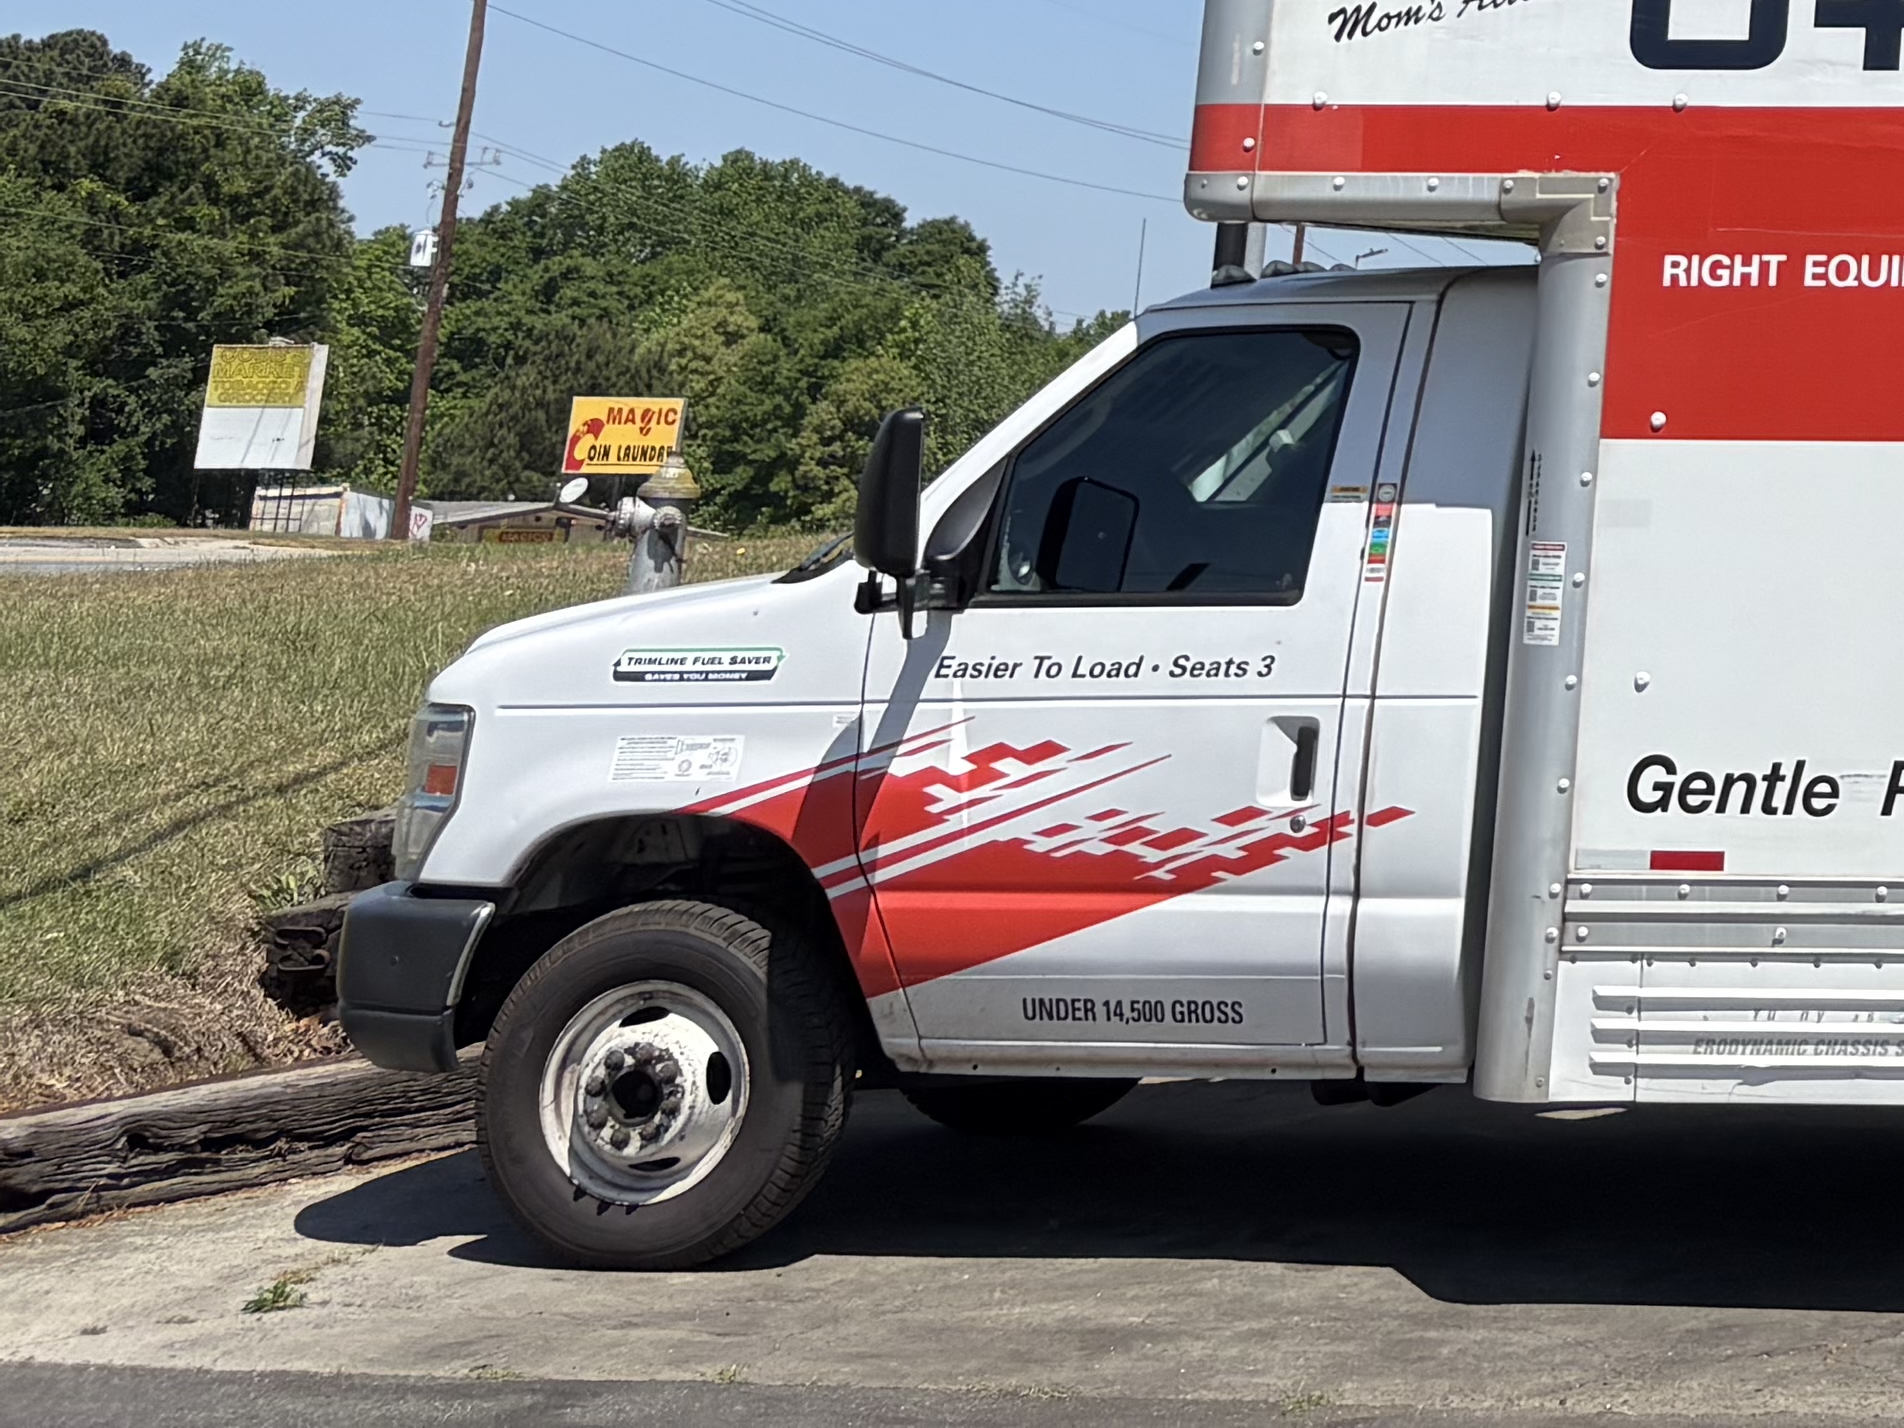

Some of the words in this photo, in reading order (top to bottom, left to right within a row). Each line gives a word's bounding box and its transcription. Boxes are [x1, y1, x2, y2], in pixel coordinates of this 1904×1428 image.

[1661, 252, 1789, 288] RIGHT
[606, 406, 678, 437] MAGIC
[627, 656, 688, 666] TRIMLINE
[692, 656, 724, 666] FUEL
[728, 655, 772, 665] SAVER
[934, 654, 1023, 679] Easier
[1032, 655, 1063, 679] To
[1071, 655, 1144, 679] Load
[1168, 654, 1250, 679] Seats
[1257, 655, 1276, 679] 3
[682, 672, 706, 681] YOU
[1625, 752, 1841, 820] Gentle
[1022, 997, 1098, 1022] UNDER
[1102, 999, 1166, 1025] 14,500
[1171, 999, 1244, 1025] GROSS
[1812, 1039, 1891, 1058] CHASSIS
